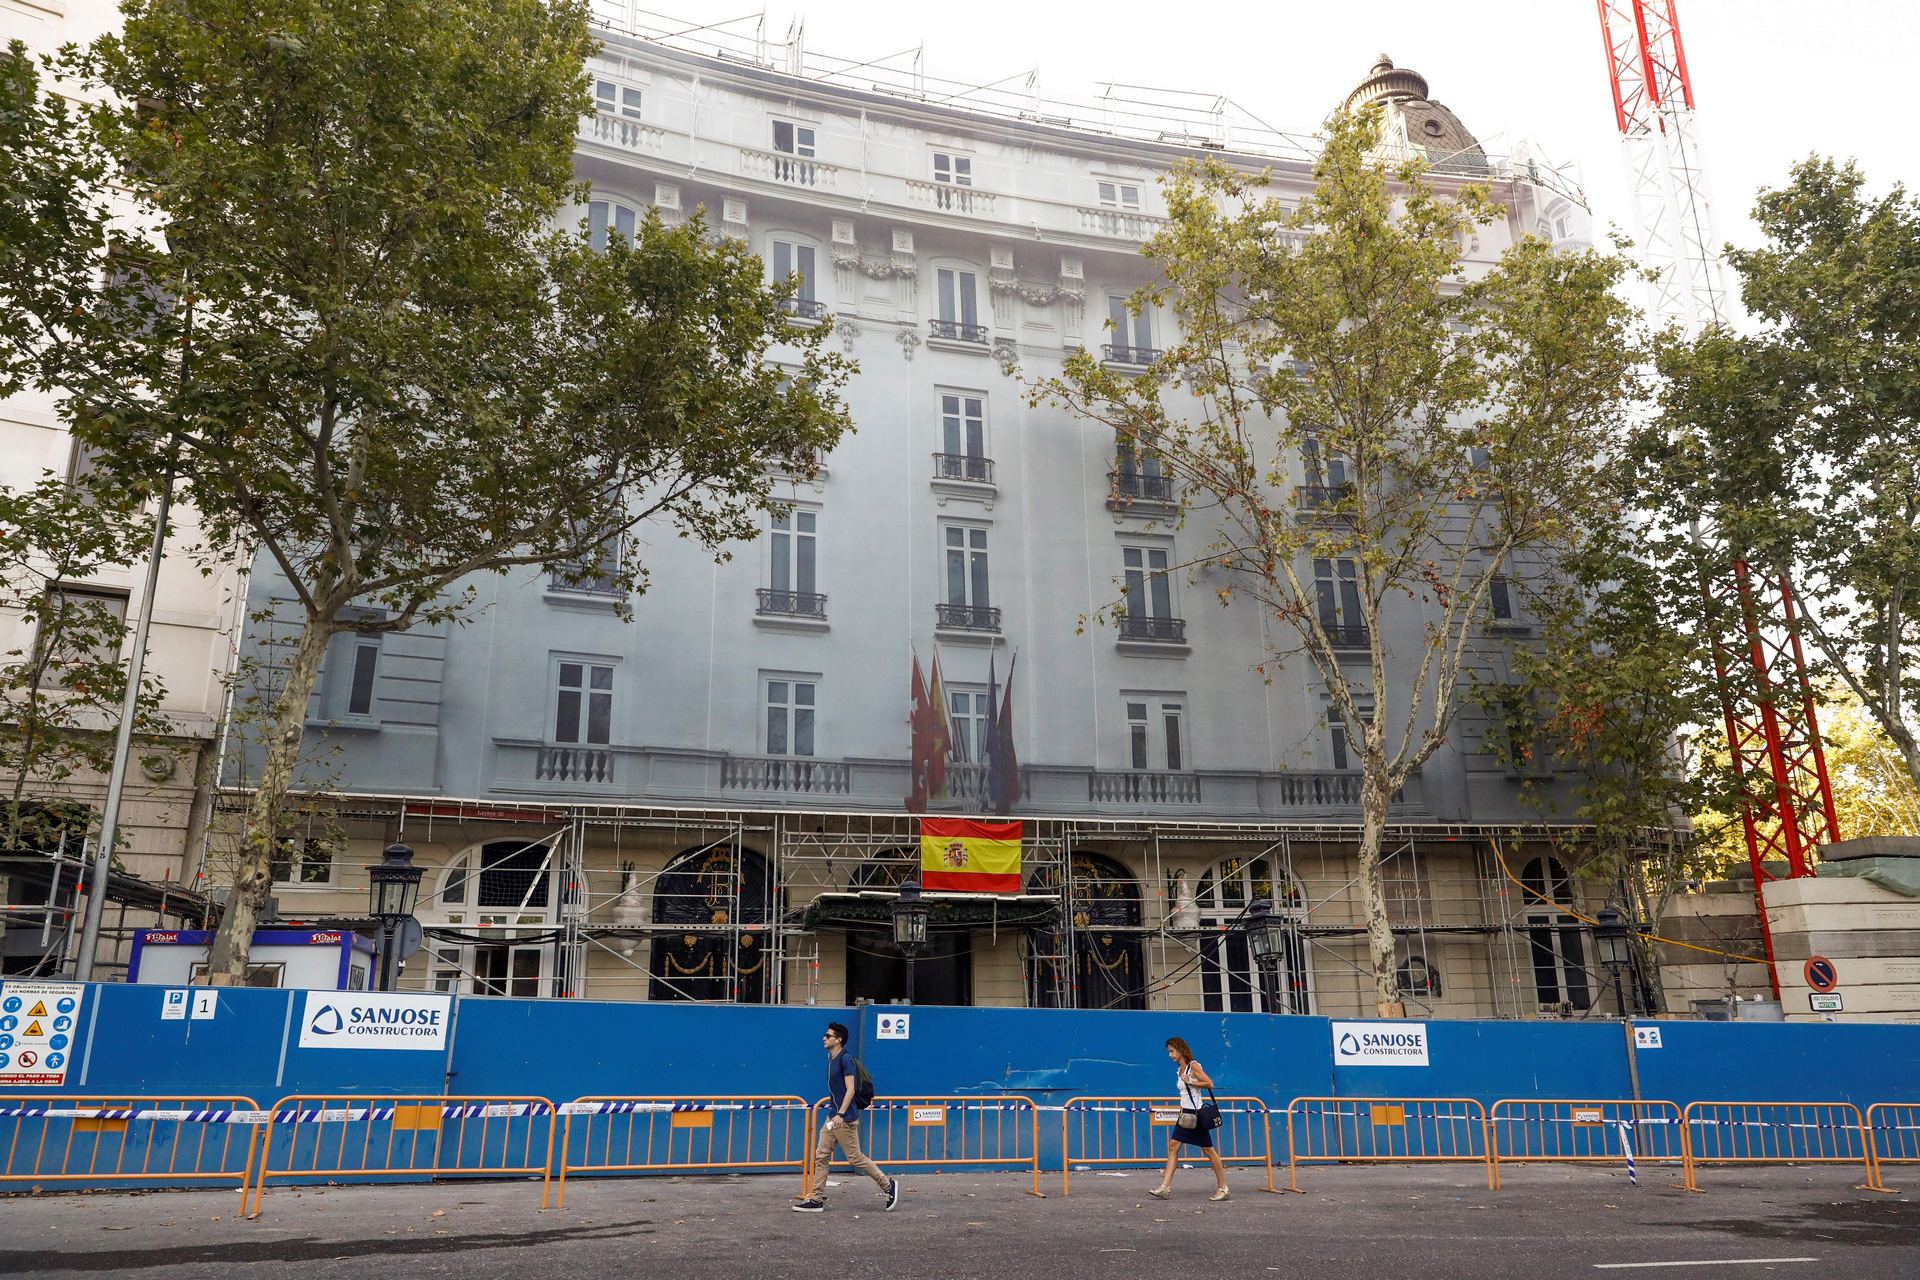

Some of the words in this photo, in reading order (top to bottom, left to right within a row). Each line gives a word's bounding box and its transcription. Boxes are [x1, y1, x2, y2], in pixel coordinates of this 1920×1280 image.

[172, 994, 180, 1003] P
[200, 999, 208, 1013] 1
[350, 1007, 440, 1025] SANJOSE
[348, 1026, 438, 1036] CONSTRUCTORA
[1363, 1034, 1422, 1046] SANJOSE
